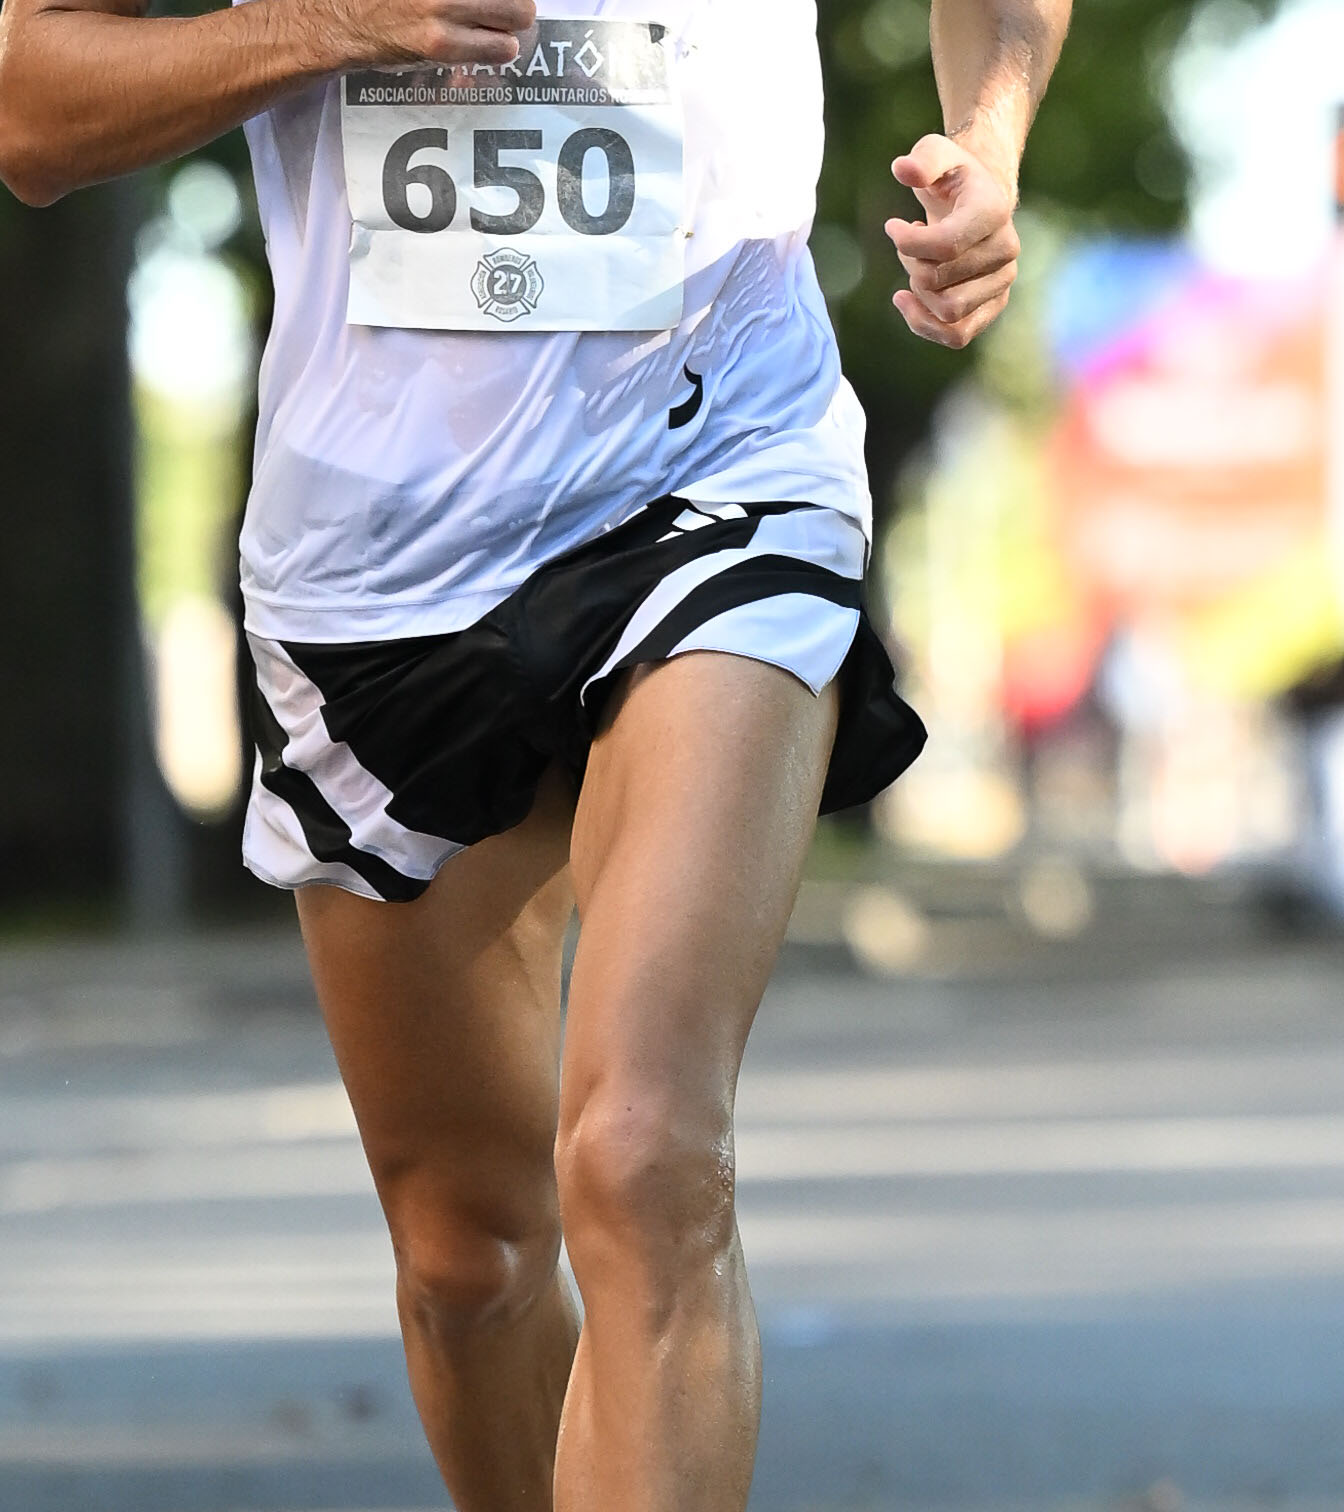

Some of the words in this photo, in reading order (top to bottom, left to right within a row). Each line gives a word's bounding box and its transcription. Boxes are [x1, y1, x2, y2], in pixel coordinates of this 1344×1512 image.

[440, 86, 514, 103] BOMBEROS
[516, 86, 607, 104] VOLUNTARIOS
[381, 127, 636, 236] 650
[493, 269, 522, 295] 27
